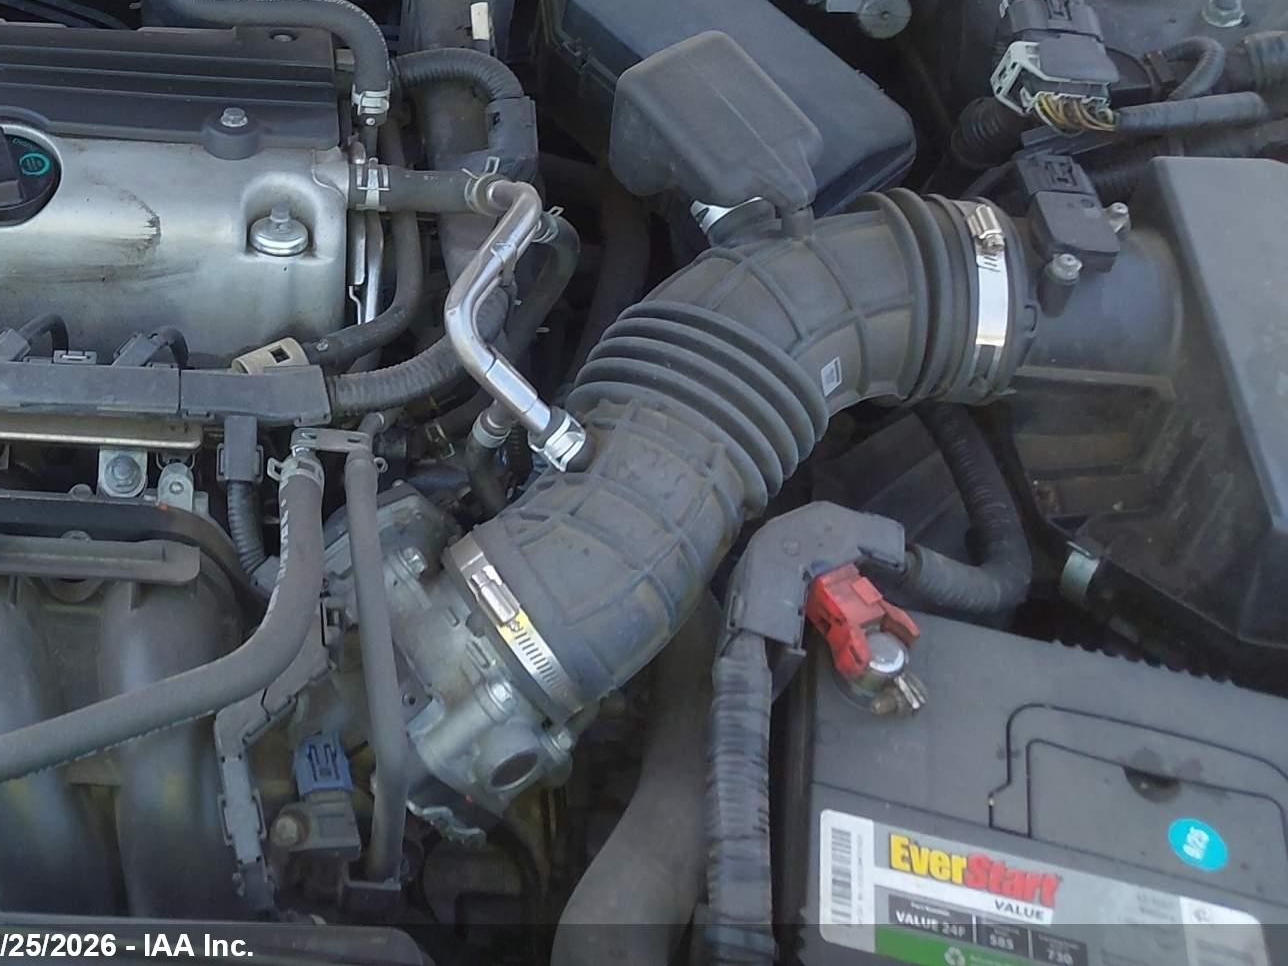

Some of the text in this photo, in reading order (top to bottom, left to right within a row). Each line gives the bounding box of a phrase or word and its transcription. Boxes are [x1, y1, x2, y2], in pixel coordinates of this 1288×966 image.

[889, 833, 1060, 908] EverStart
[895, 910, 940, 933] VALUE
[994, 899, 1047, 922] VALUE
